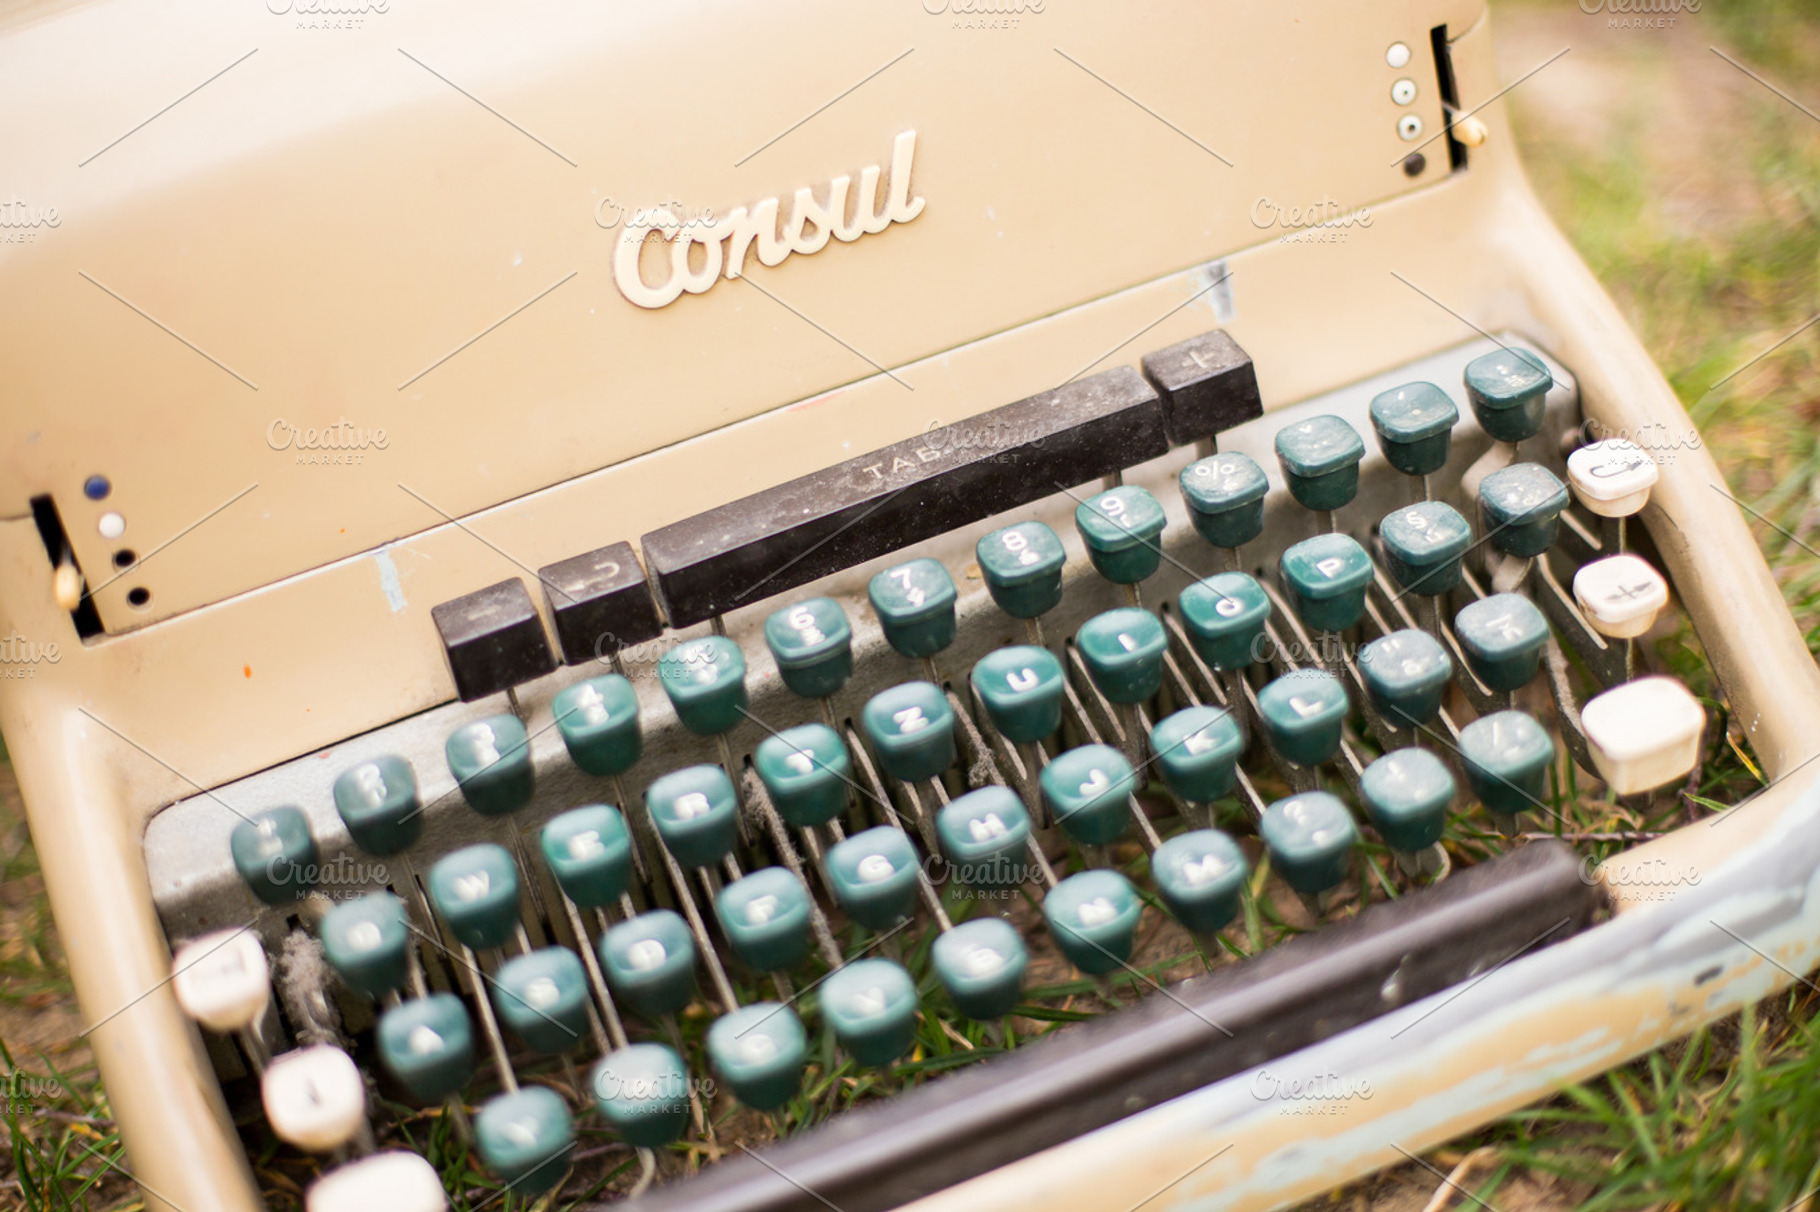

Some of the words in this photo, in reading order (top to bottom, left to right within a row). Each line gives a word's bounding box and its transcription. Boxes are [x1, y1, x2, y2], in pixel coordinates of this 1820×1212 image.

[613, 128, 926, 309] Consul
[1194, 460, 1236, 481] %
[1101, 499, 1125, 519] 9
[1001, 530, 1028, 552] 8
[890, 567, 912, 590] 7
[1316, 557, 1346, 579] P
[789, 606, 816, 630] 6
[1006, 667, 1040, 693] U
[893, 706, 930, 734] Z
[1289, 697, 1326, 717] L
[1183, 729, 1218, 756] K
[785, 749, 815, 775] T
[1079, 768, 1110, 798] J
[968, 812, 1008, 842] H
[568, 829, 605, 860] E
[1183, 853, 1226, 885] M
[456, 869, 490, 900] W
[1078, 896, 1118, 927] N
